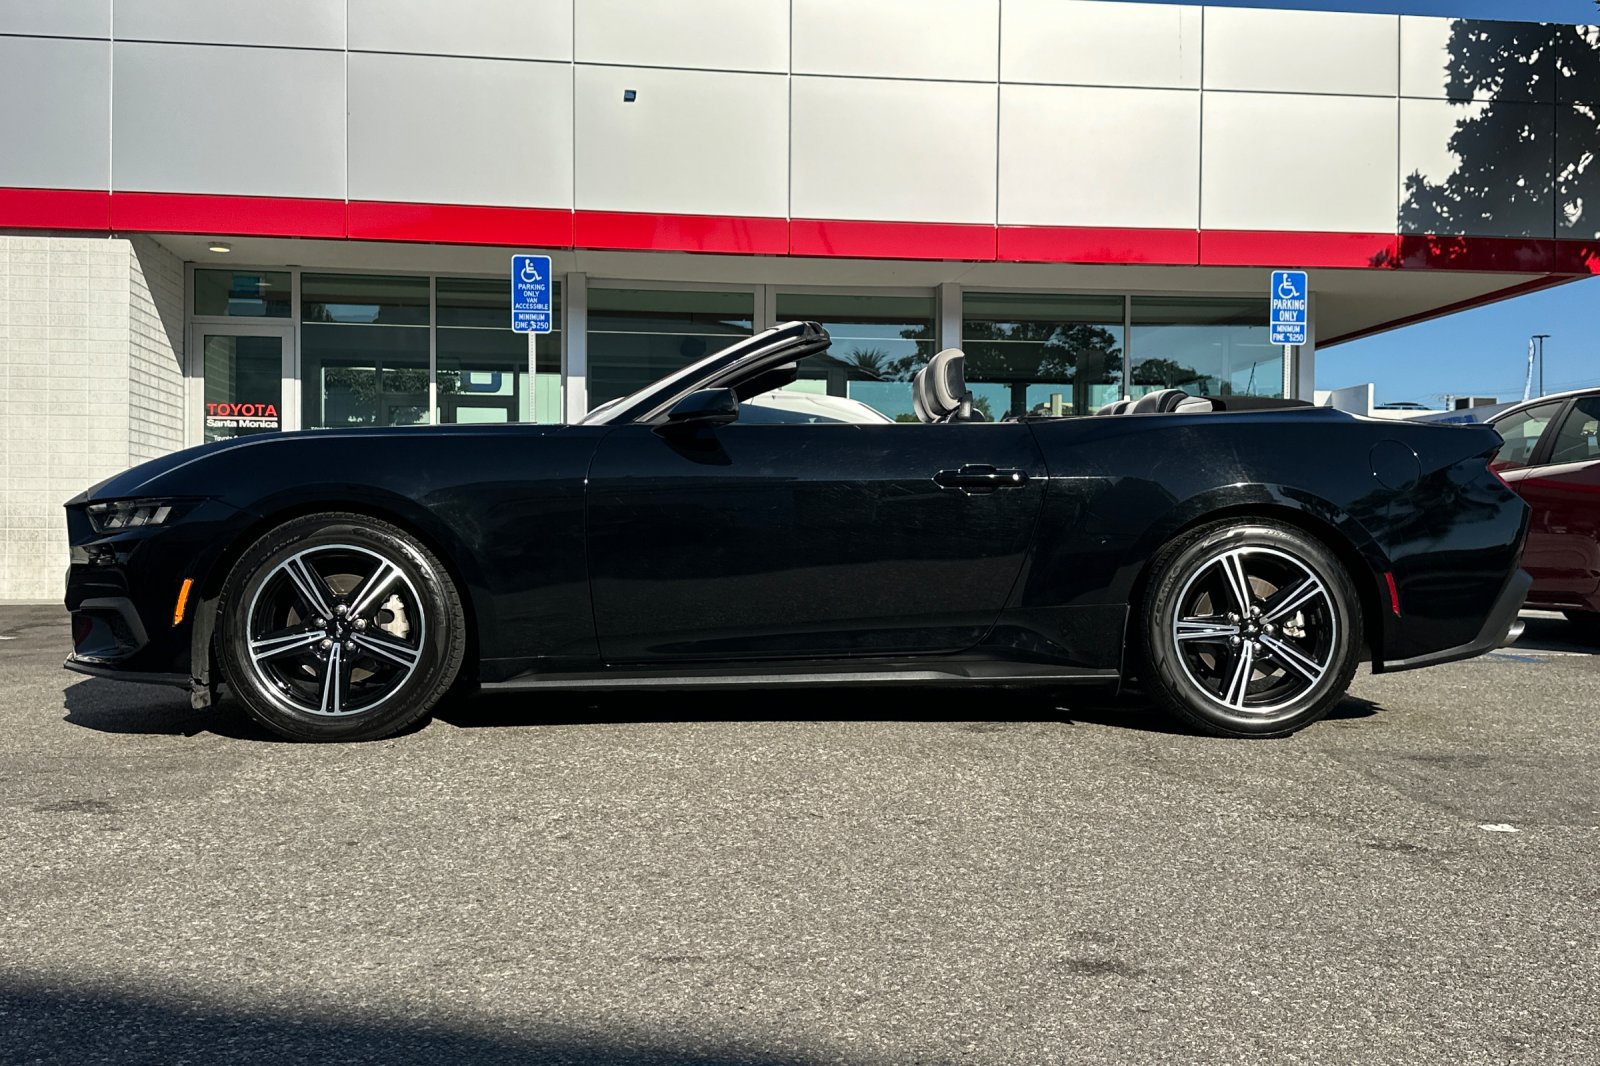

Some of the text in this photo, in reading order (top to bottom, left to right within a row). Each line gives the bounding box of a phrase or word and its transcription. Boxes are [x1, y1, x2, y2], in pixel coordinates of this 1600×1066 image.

[1273, 299, 1304, 310] PARKING
[518, 313, 545, 321] MINIMUM
[1279, 311, 1298, 321] ONLY
[1272, 333, 1285, 341] FINE
[207, 403, 277, 416] TOYOTA
[206, 419, 279, 429] Santa Monica
